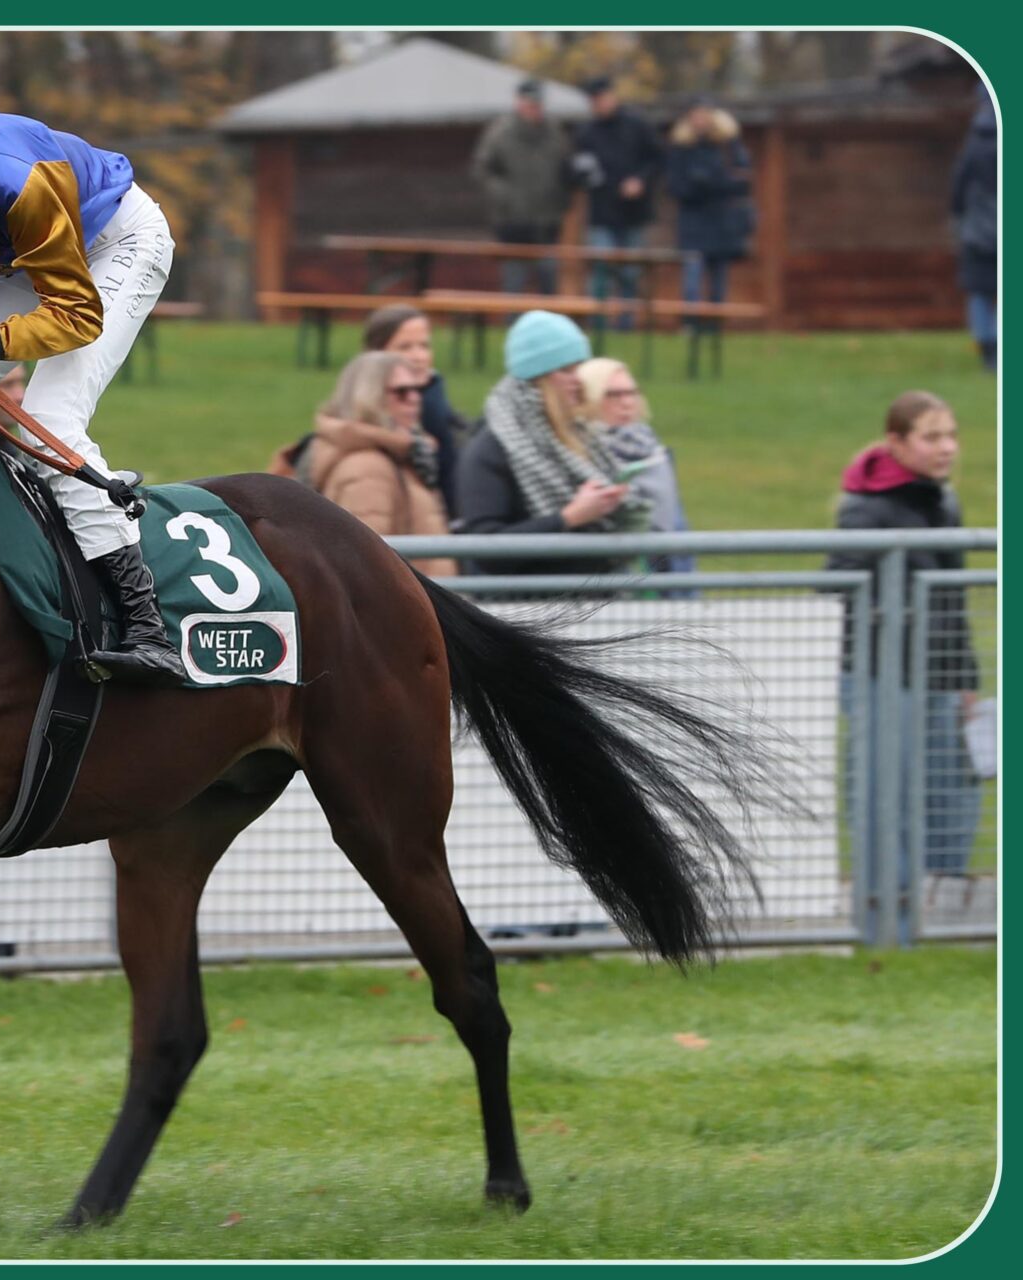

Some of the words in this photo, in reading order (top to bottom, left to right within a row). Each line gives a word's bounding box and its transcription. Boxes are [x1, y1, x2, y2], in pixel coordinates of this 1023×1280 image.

[166, 511, 261, 612] 3
[198, 629, 253, 649] WETT
[216, 649, 265, 668] STAR
